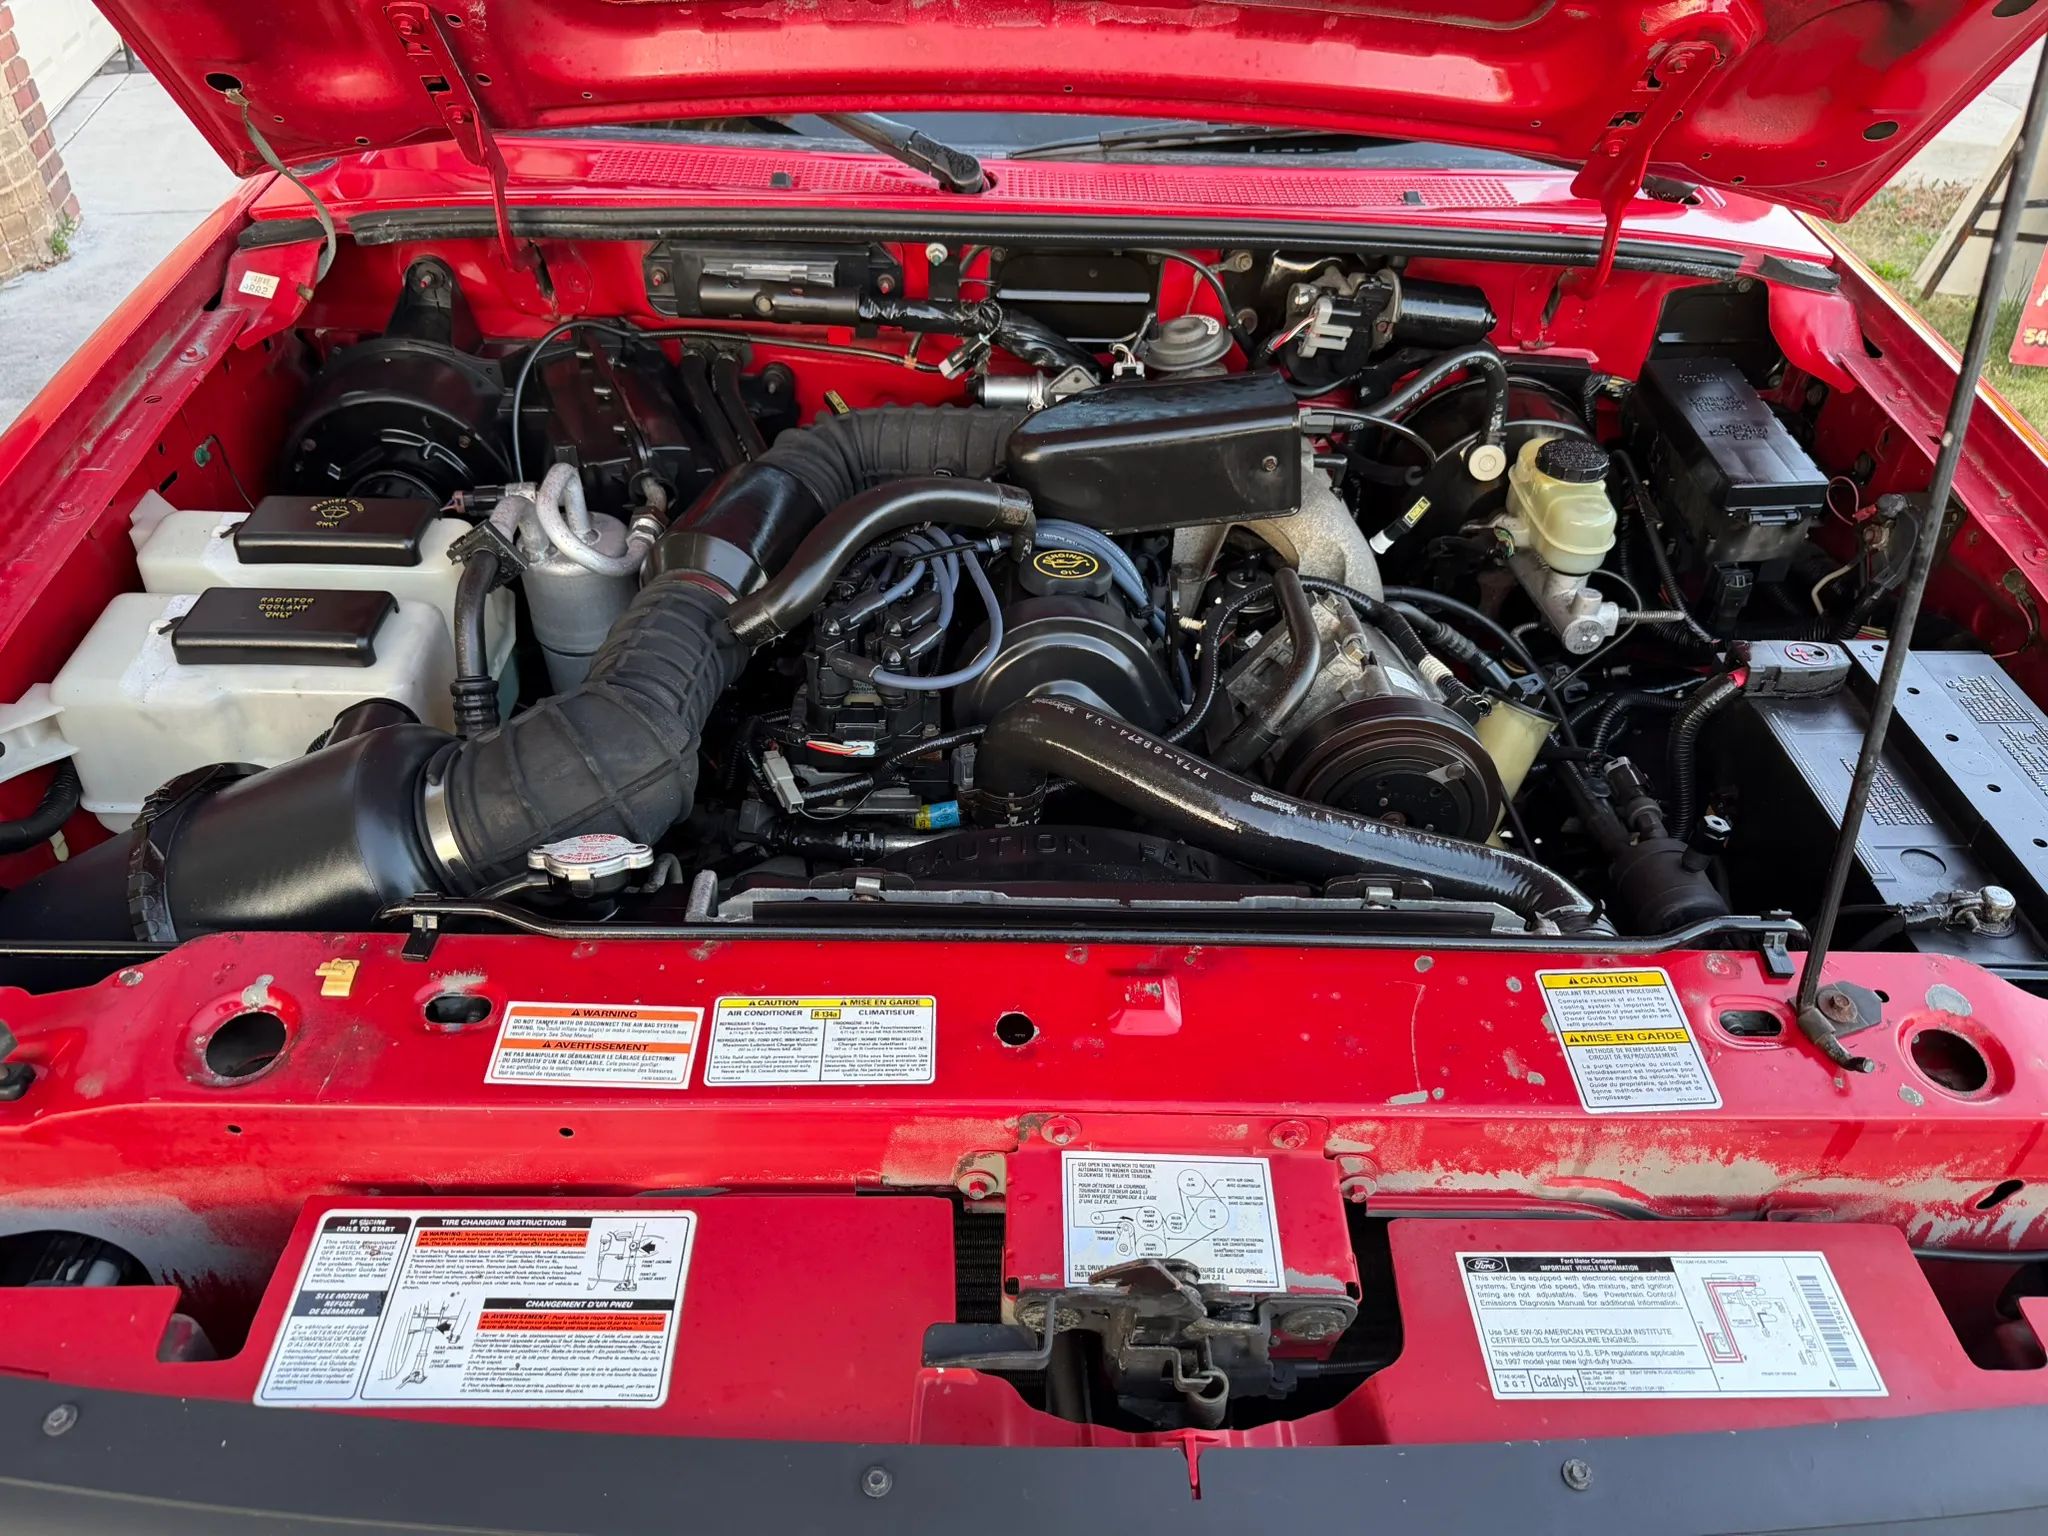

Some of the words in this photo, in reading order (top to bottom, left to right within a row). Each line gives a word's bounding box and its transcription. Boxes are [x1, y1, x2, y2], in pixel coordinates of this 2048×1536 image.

[1044, 553, 1084, 561] ENGINE
[1138, 842, 1213, 880] FAN
[1580, 975, 1638, 983] CAUTION
[583, 1009, 637, 1017] WARNING
[814, 1011, 838, 1019] R-134a
[1580, 1033, 1613, 1042] MISE
[1637, 1031, 1683, 1040] GARDE
[553, 1041, 649, 1051] AVERTISSEMENT
[1473, 1260, 1497, 1271] Ford
[1590, 1258, 1617, 1266] Company
[1528, 1274, 1561, 1282] equipped
[1619, 1274, 1643, 1282] engine
[1510, 1282, 1536, 1290] Engine
[1646, 1283, 1673, 1291] ignition
[1477, 1291, 1500, 1299] timing
[1519, 1299, 1555, 1307] Diagnosis
[1611, 1349, 1648, 1357] regulations
[1650, 1349, 1684, 1357] applicable
[1534, 1374, 1578, 1390] Catalyst
